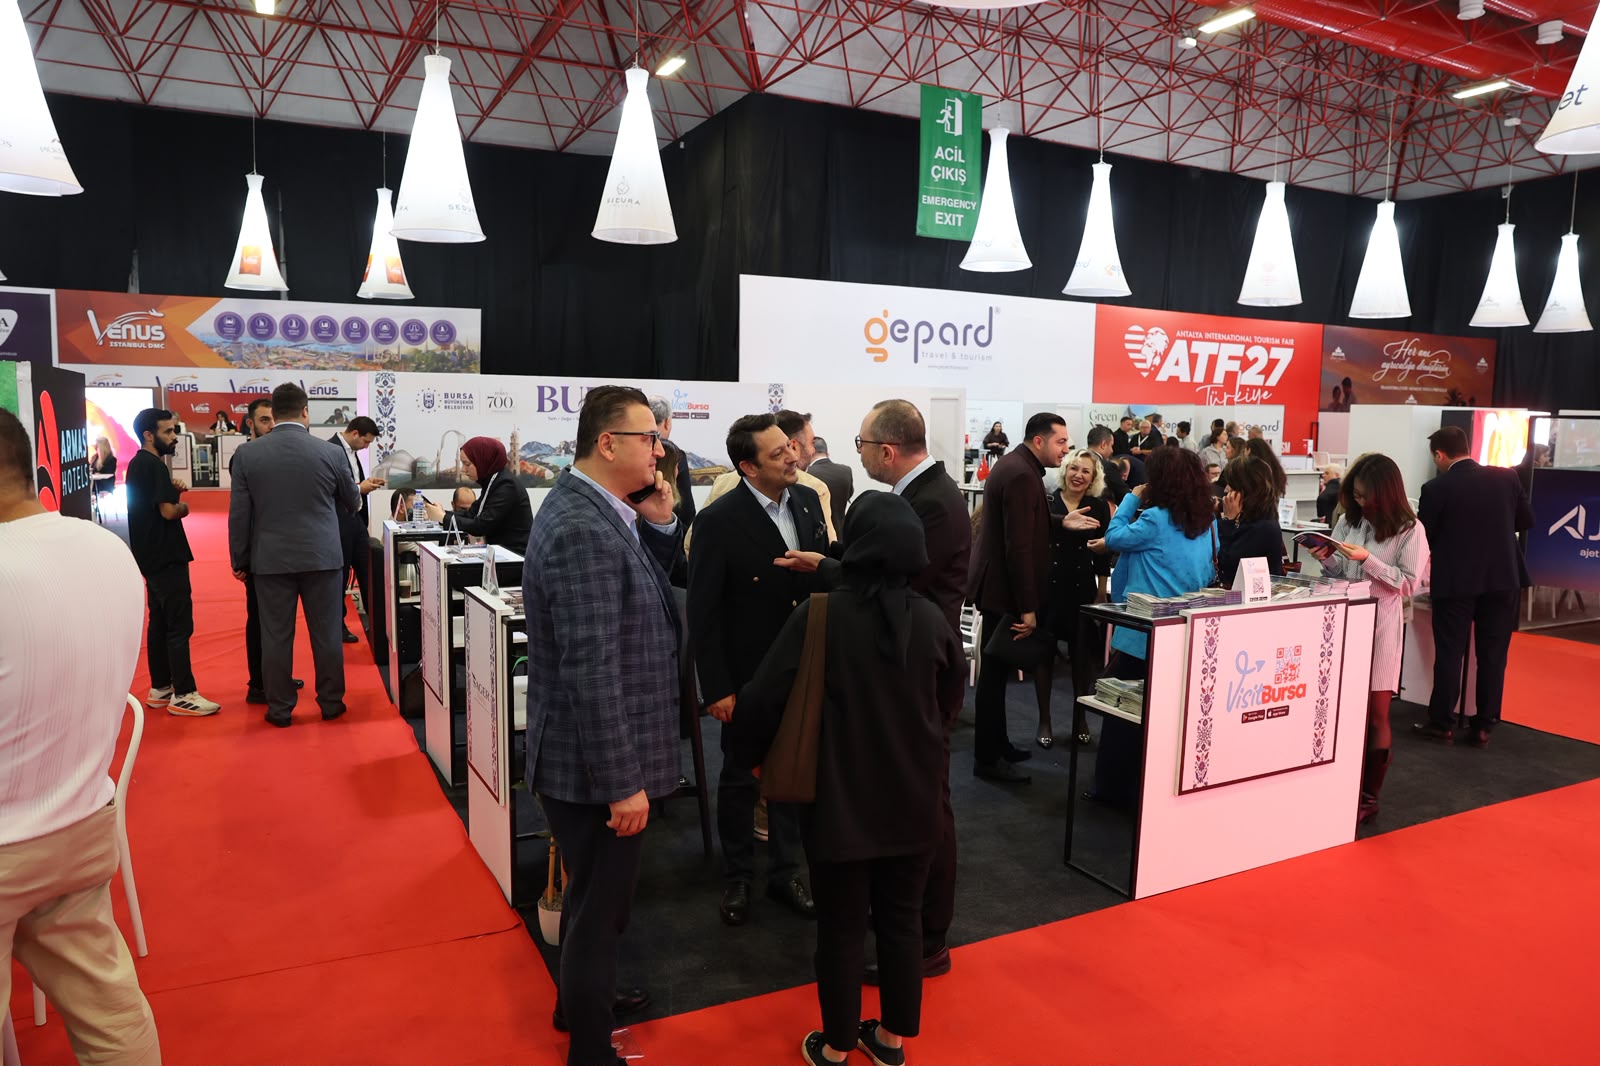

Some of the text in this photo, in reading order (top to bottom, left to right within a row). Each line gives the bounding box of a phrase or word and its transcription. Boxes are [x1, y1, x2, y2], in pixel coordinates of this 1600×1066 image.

[934, 146, 965, 163] ACİL
[931, 165, 967, 185] ÇIKIŞ
[922, 195, 977, 210] EMERGENCY
[935, 211, 964, 227] EXIT
[864, 306, 993, 364] gepard
[1176, 330, 1203, 339] ANTALYA
[1204, 332, 1252, 343] INTERNATIONAL
[1254, 335, 1280, 345] TOURISM
[921, 351, 993, 361] travel & tourism
[1155, 339, 1295, 387] ATF27
[444, 392, 474, 400] BURSA
[1195, 370, 1272, 406] Türkiye
[487, 396, 514, 409] 700
[536, 385, 599, 414] BU
[1089, 409, 1118, 422] Green
[61, 428, 87, 464] ARMAS
[62, 463, 89, 497] HOTELS
